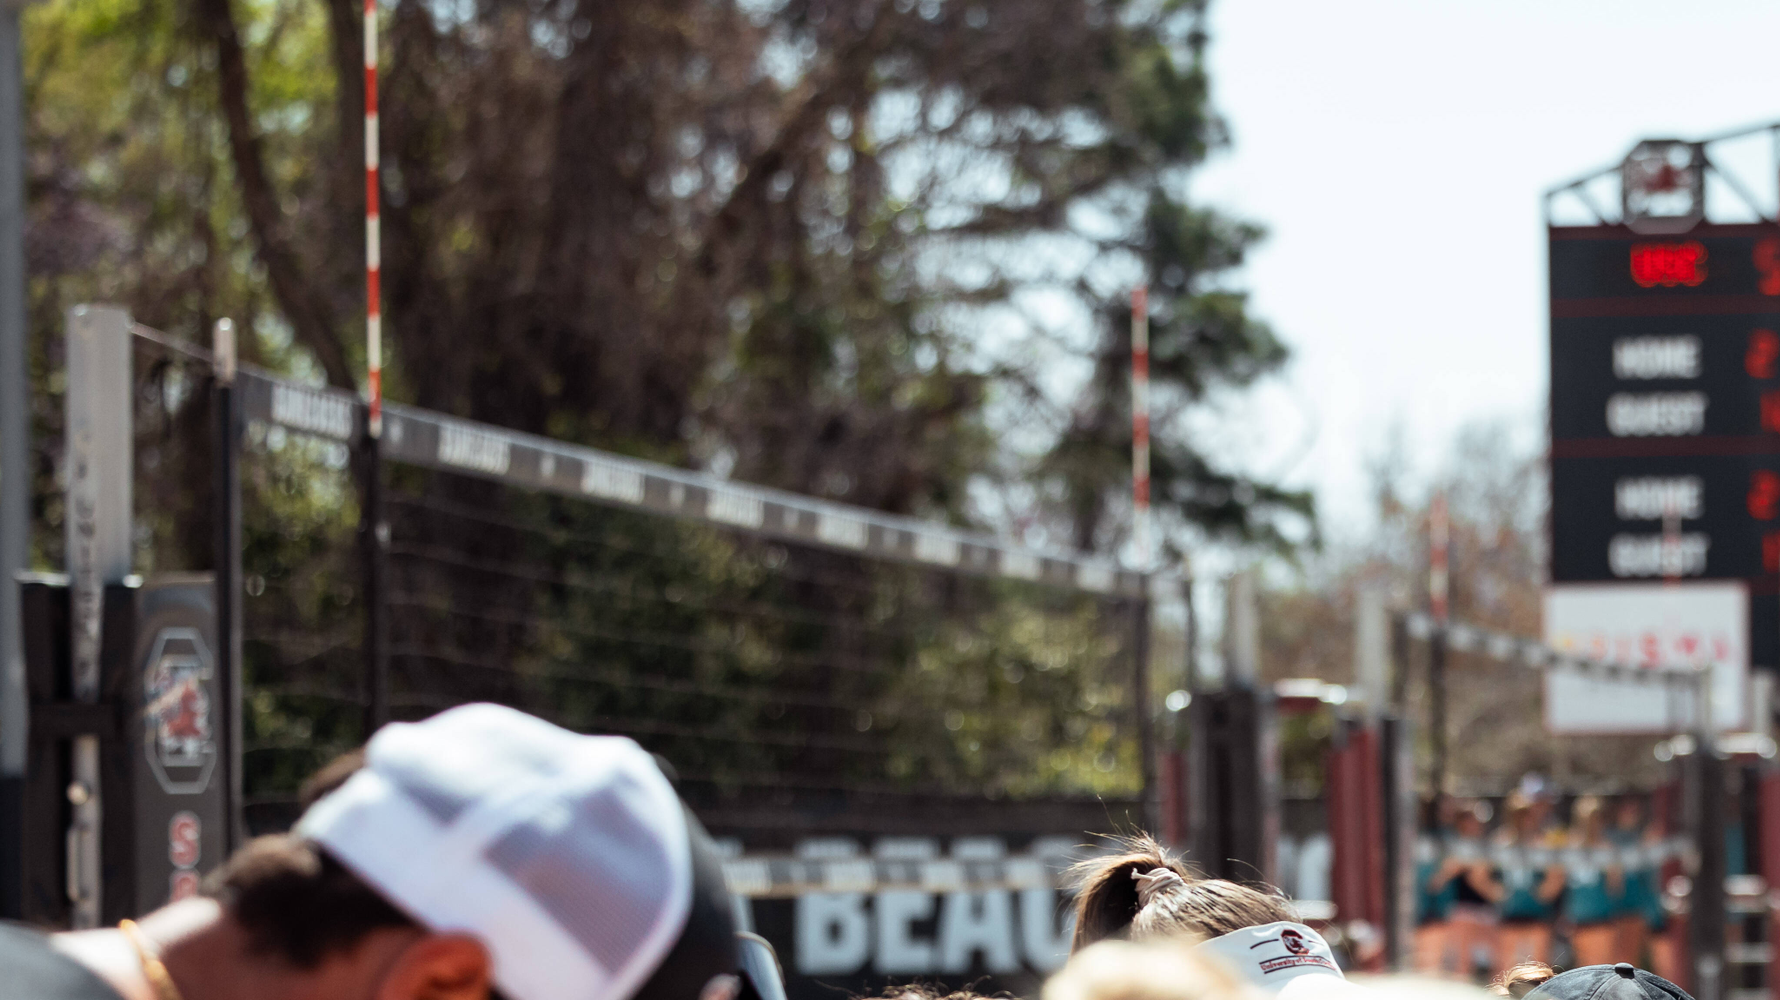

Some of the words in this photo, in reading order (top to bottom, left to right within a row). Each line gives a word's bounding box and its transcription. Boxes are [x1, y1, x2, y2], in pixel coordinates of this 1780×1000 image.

[1612, 335, 1702, 379] HOME
[1606, 391, 1709, 436] GUEST
[1615, 476, 1703, 519] HOME
[1608, 532, 1710, 577] GUEST
